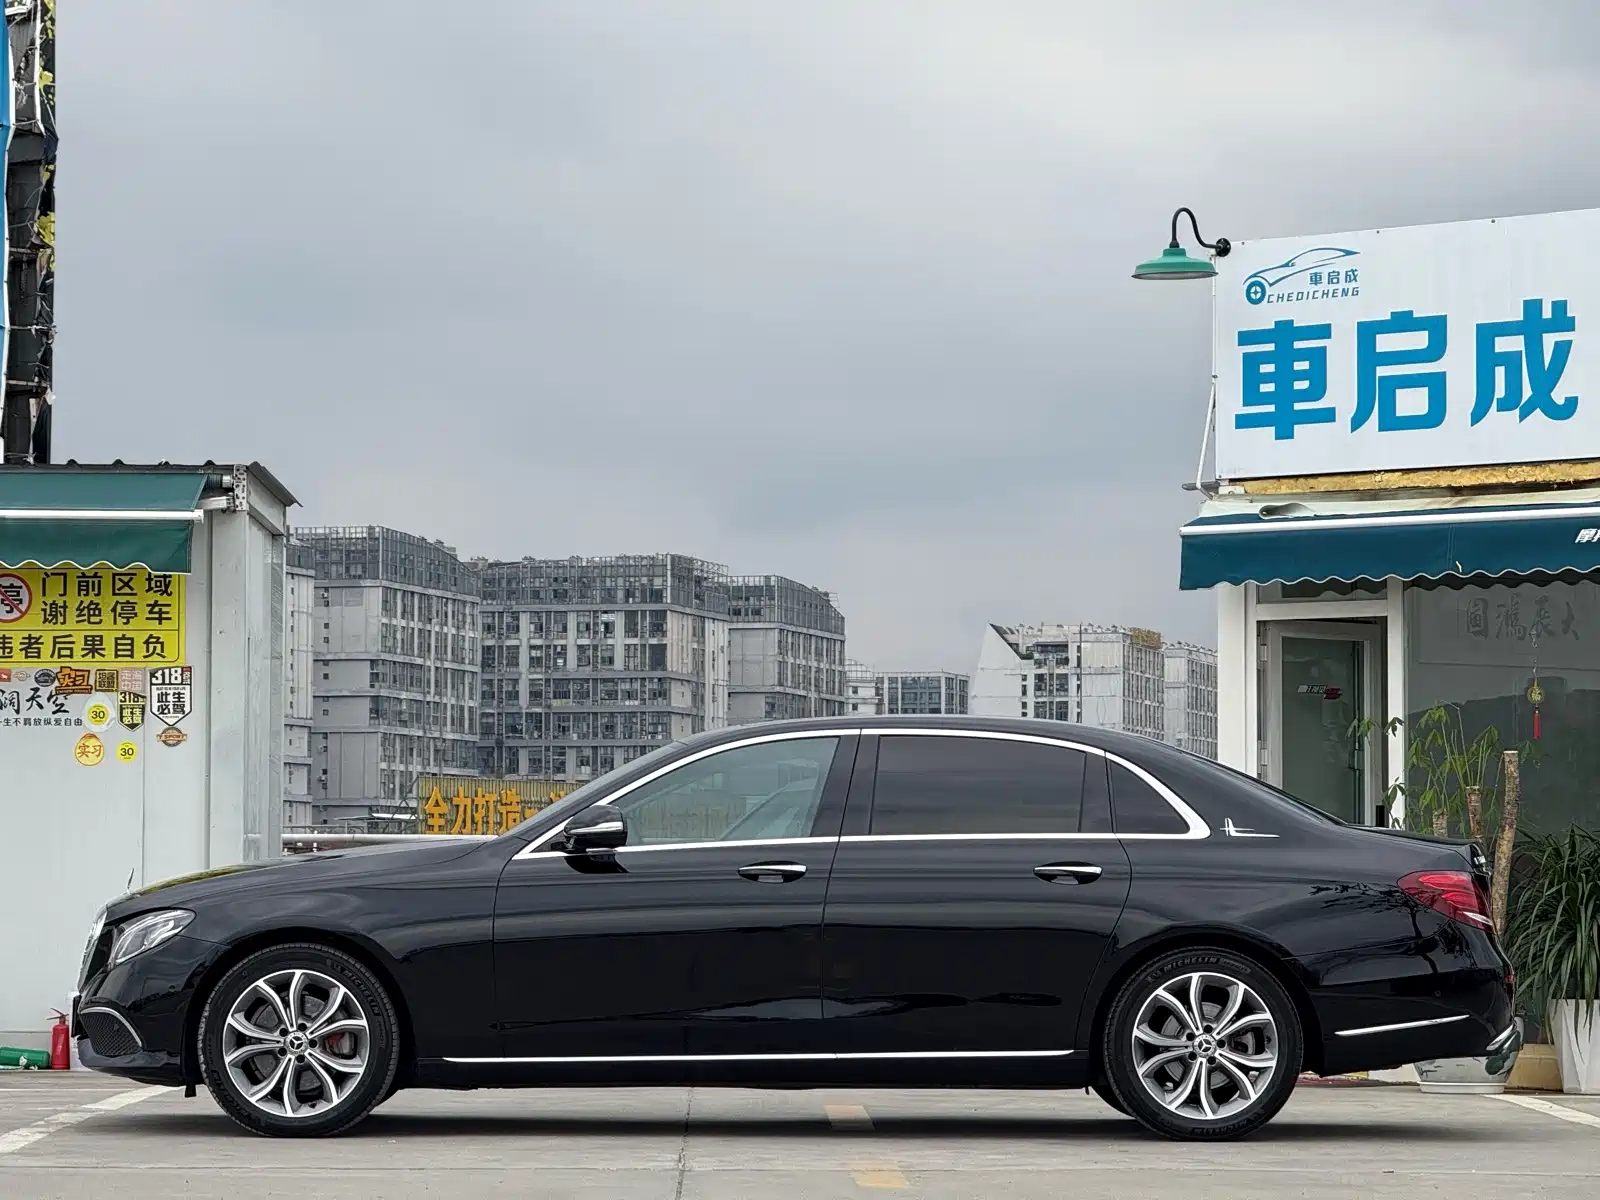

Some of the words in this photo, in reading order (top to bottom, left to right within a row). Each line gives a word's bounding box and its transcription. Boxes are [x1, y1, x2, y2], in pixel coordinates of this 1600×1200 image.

[1308, 268, 1359, 288] 車启成
[1234, 298, 1579, 441] 車启成
[40, 571, 173, 597] 门前区域
[40, 599, 173, 626] 谢绝停车
[152, 667, 182, 684] 318
[0, 687, 70, 715] 阔天空
[91, 711, 105, 719] 30
[77, 743, 102, 758] 实习
[120, 748, 134, 757] 30
